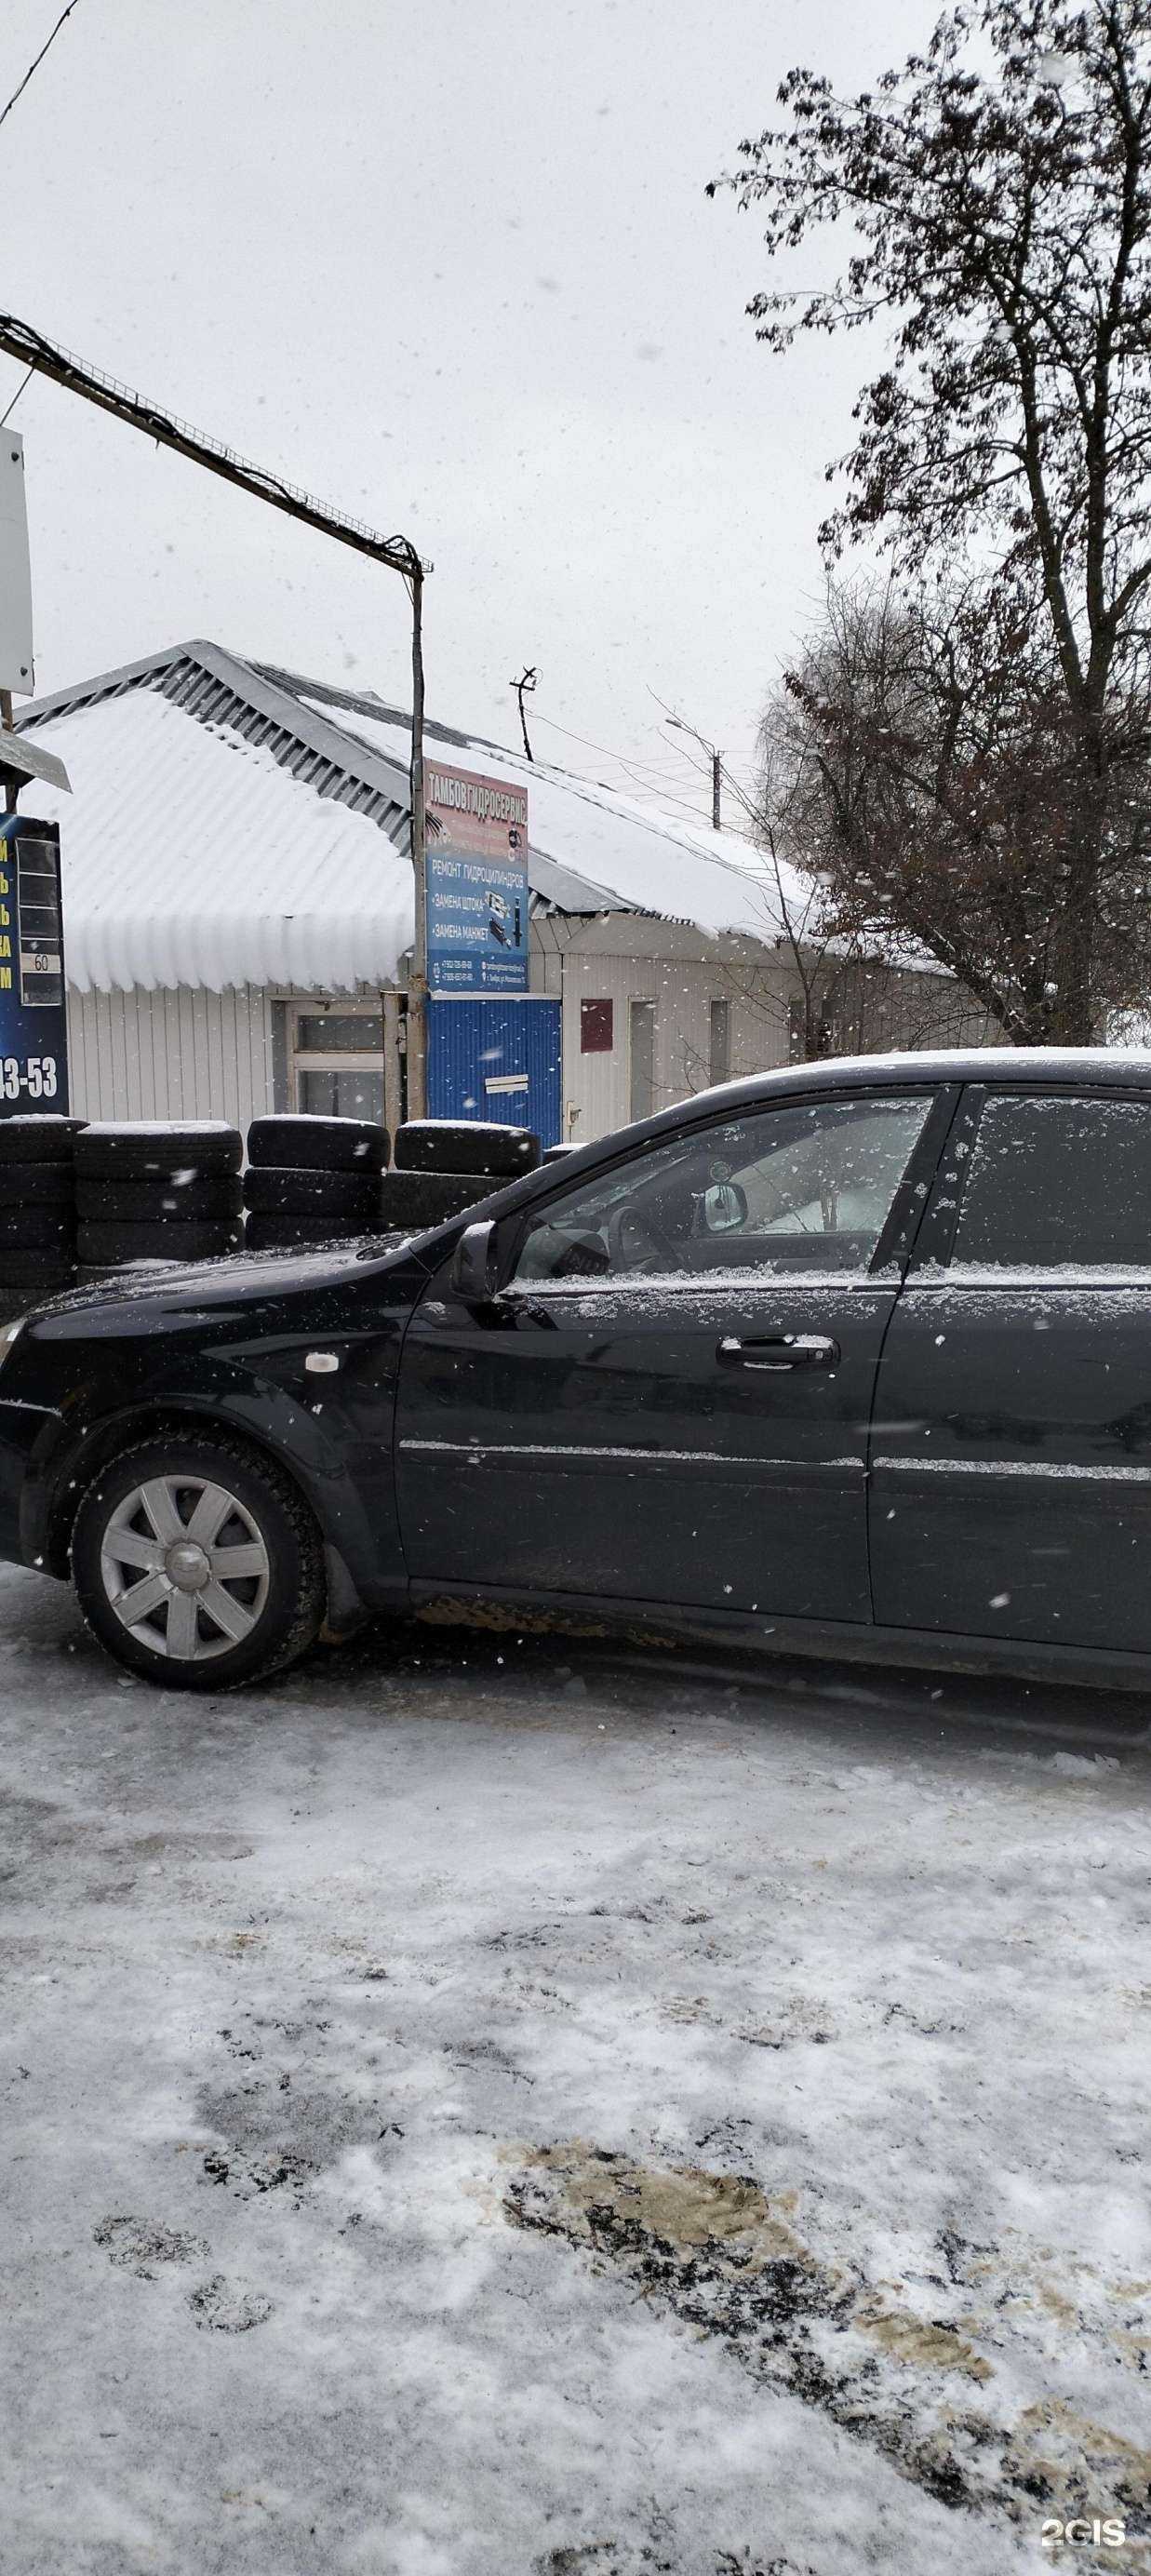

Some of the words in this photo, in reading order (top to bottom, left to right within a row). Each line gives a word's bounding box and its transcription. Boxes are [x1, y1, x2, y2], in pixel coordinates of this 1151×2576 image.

[433, 859, 462, 879] РЕМОНТ
[463, 864, 524, 889] ГИДРОЦИЛИНДРОВ
[435, 893, 462, 909] ЗАМЕНА
[435, 923, 462, 939] ЗАМЕНА
[35, 954, 48, 972] 60
